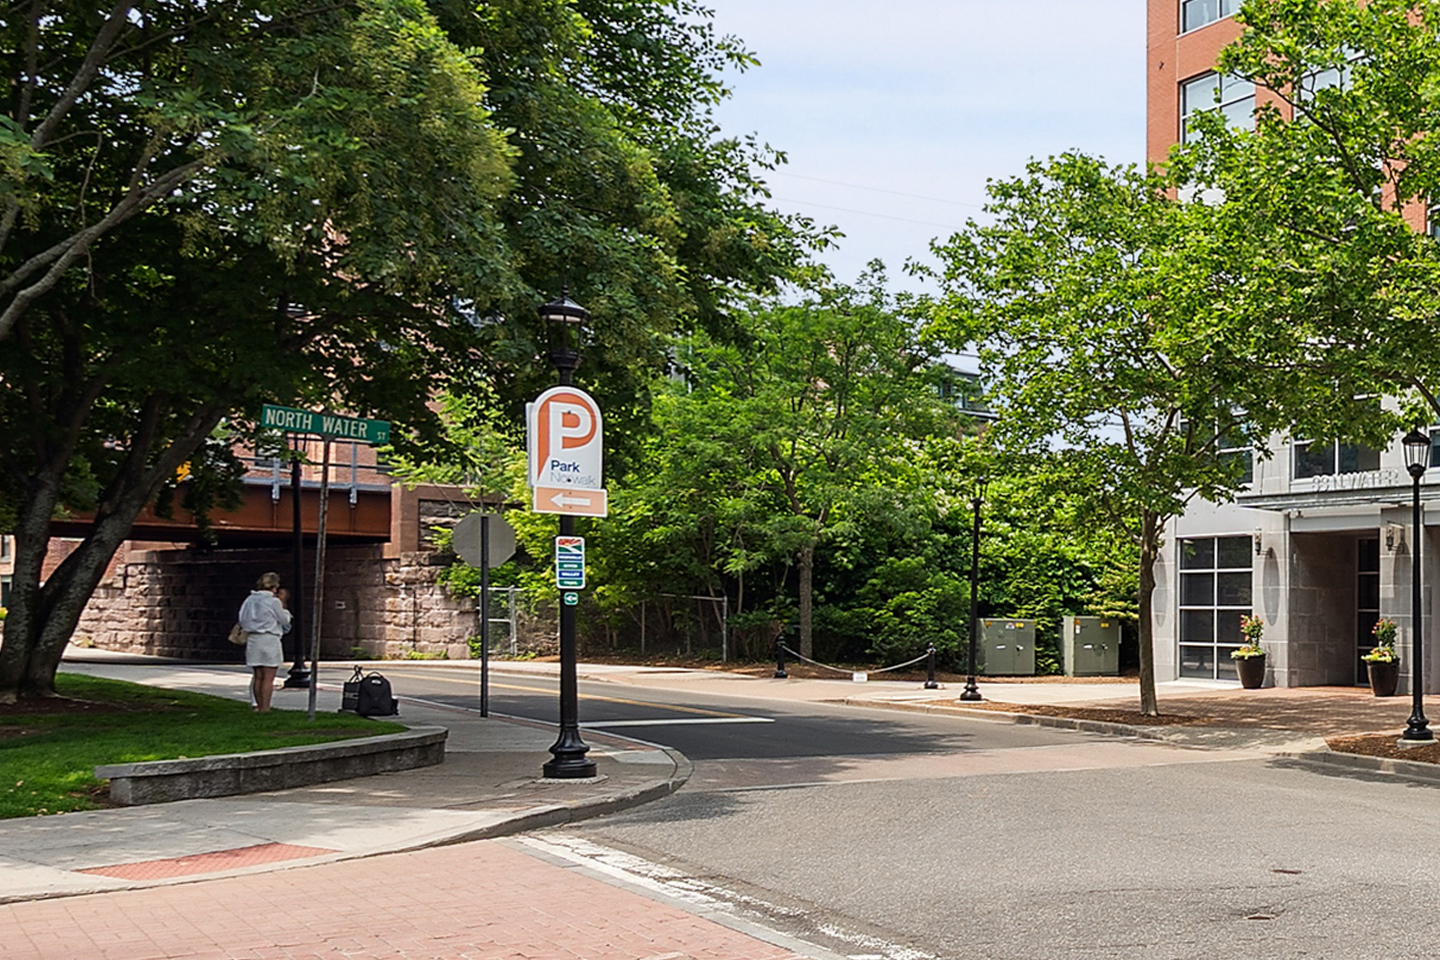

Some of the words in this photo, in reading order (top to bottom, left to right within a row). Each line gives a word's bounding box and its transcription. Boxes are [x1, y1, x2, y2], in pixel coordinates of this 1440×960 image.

[265, 408, 313, 430] NORTH
[322, 416, 368, 438] WATER
[376, 431, 386, 441] ST
[548, 401, 592, 452] P
[550, 460, 580, 473] Park
[1346, 469, 1399, 489] WATER
